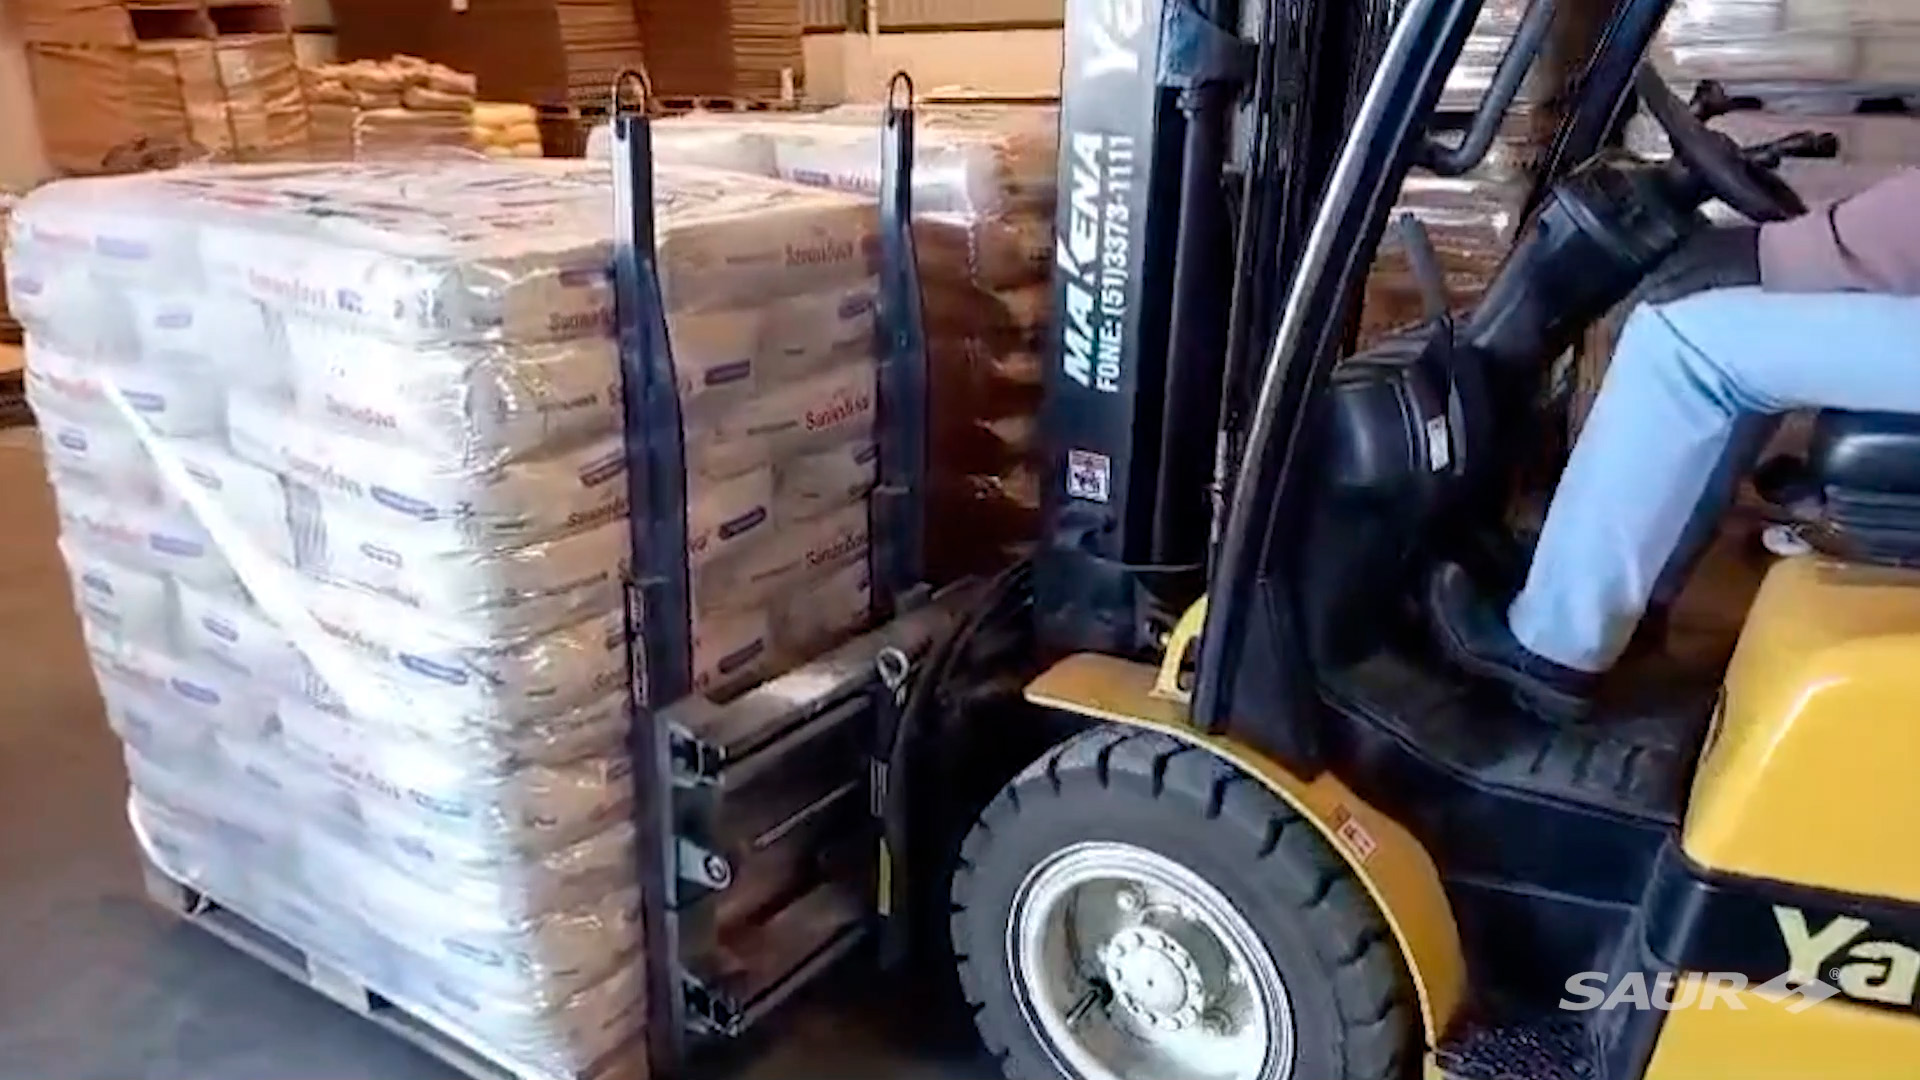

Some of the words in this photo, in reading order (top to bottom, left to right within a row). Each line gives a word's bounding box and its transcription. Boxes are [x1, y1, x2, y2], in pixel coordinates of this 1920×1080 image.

[1057, 131, 1103, 388] MAKENA
[1101, 134, 1135, 316] (51)3373-1111
[1095, 322, 1123, 393] FONE:
[1772, 904, 1920, 1006] Ya
